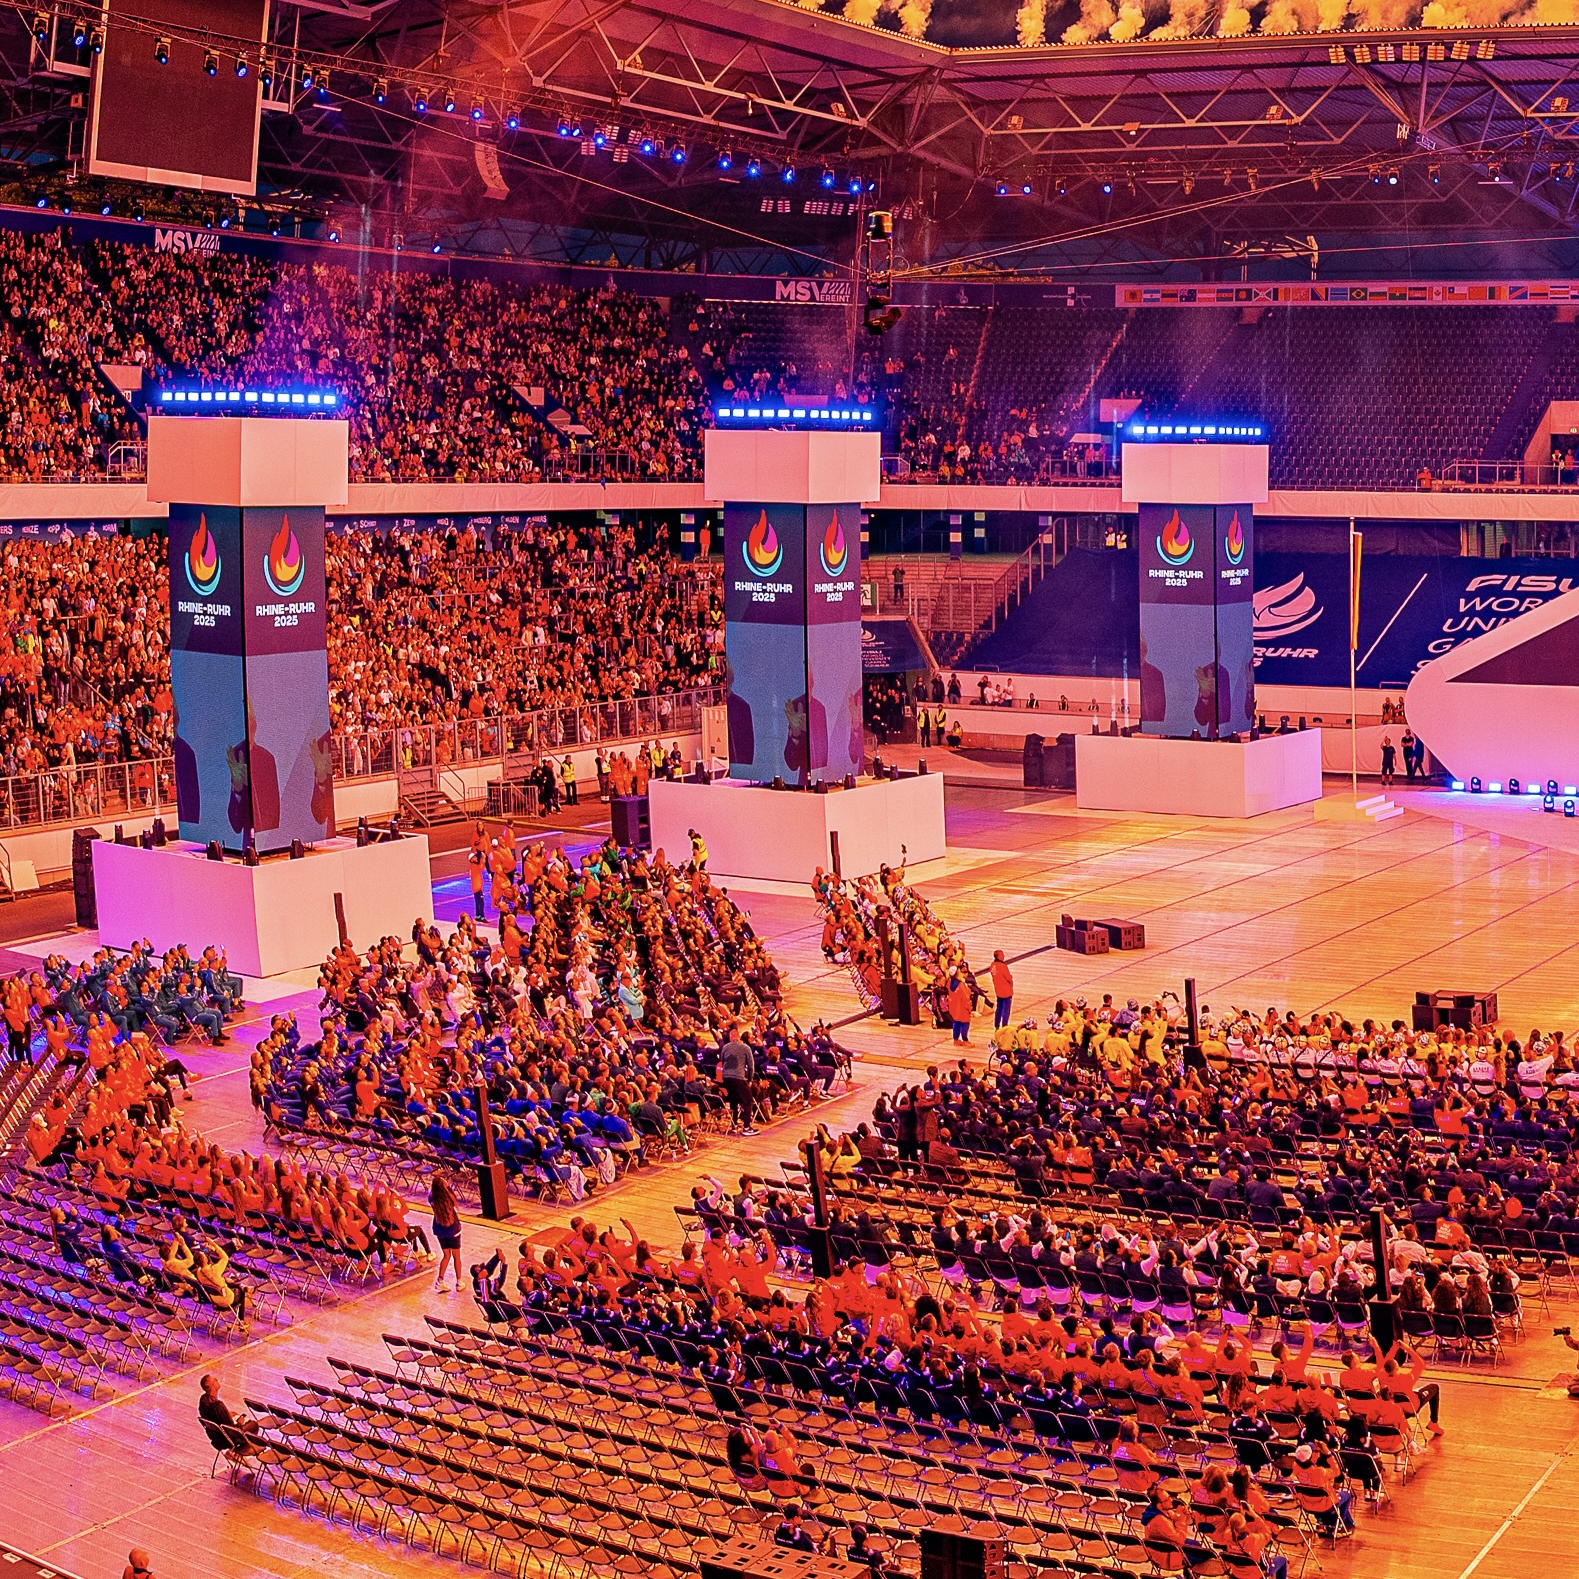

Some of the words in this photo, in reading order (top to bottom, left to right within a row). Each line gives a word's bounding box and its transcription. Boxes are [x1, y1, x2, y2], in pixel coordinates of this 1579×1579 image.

[775, 280, 830, 302] MSV
[1149, 569, 1203, 579] RHINE-RUHR
[734, 581, 793, 593] RHINE-RUHR
[814, 581, 854, 593] RHINE-RUHR
[1165, 578, 1187, 586] 2025
[752, 592, 775, 602] 2025
[826, 592, 843, 602] 2025
[178, 601, 231, 616] RHINE-RUHR
[255, 602, 315, 616] RHINE-RUHR
[193, 615, 216, 627] 2025
[274, 615, 298, 627] 2025
